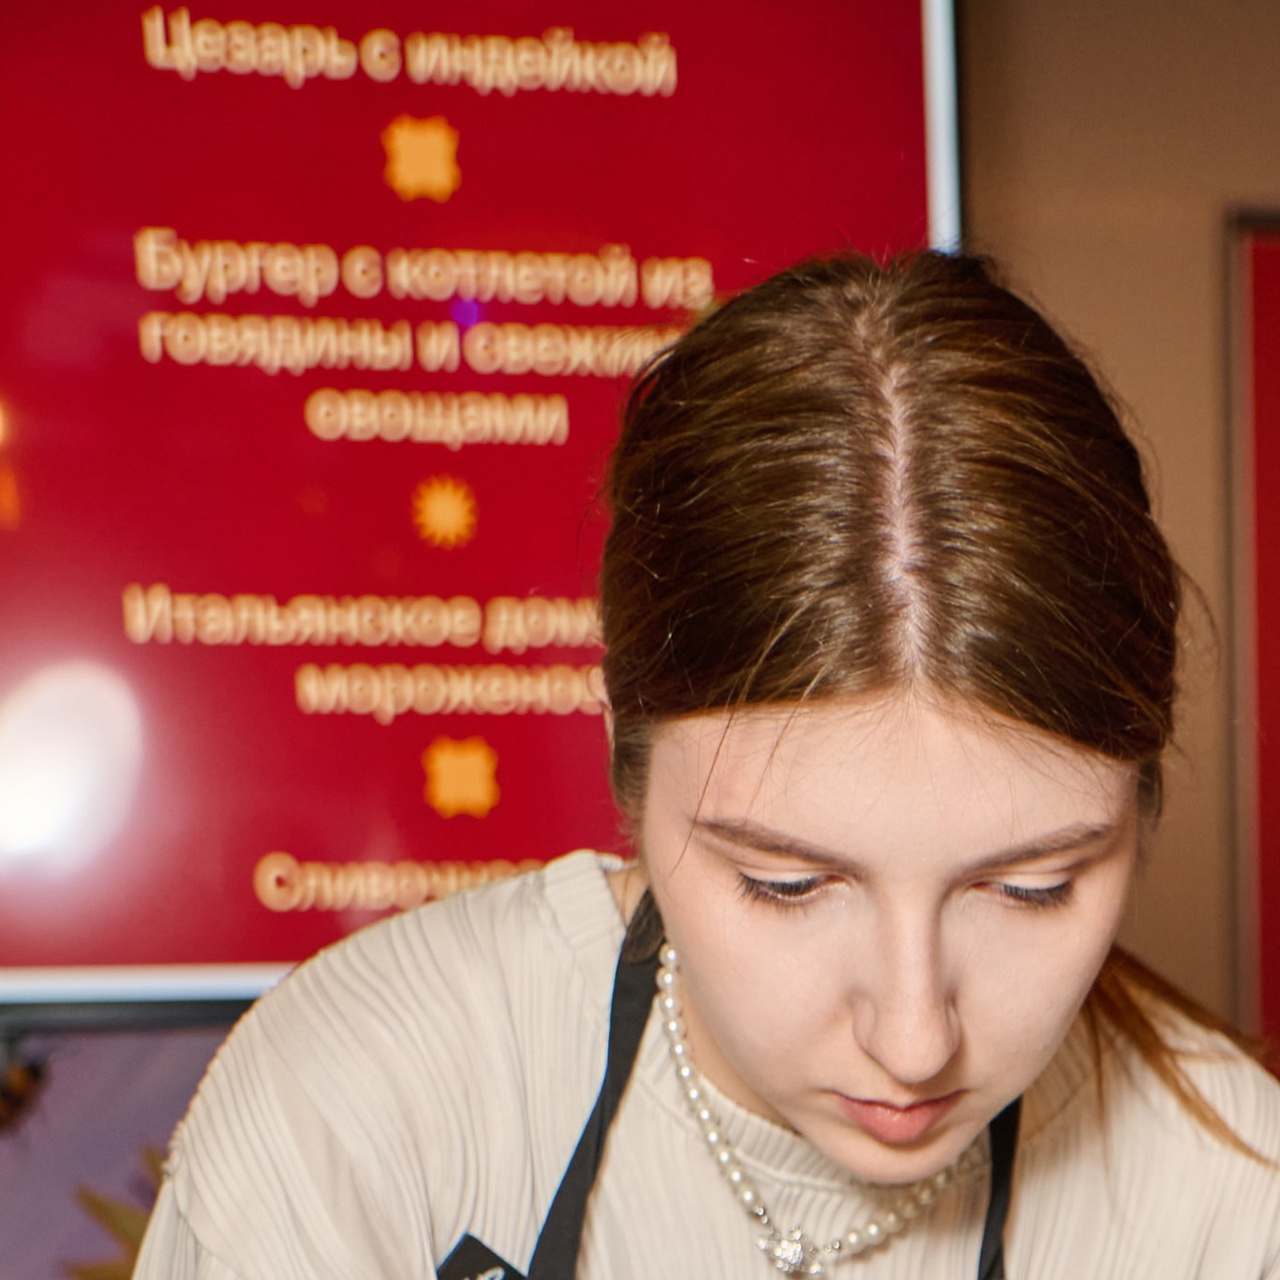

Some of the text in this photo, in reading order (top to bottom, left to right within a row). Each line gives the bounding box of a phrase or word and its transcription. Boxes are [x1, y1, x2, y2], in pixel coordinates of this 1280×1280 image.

[142, 6, 678, 97] Цезарь с индейкой
[134, 226, 714, 310] Бургер с котлетой из
[138, 312, 413, 375] говядины
[416, 321, 460, 371] и
[304, 387, 569, 450] овощами
[122, 583, 482, 646] Итальянское
